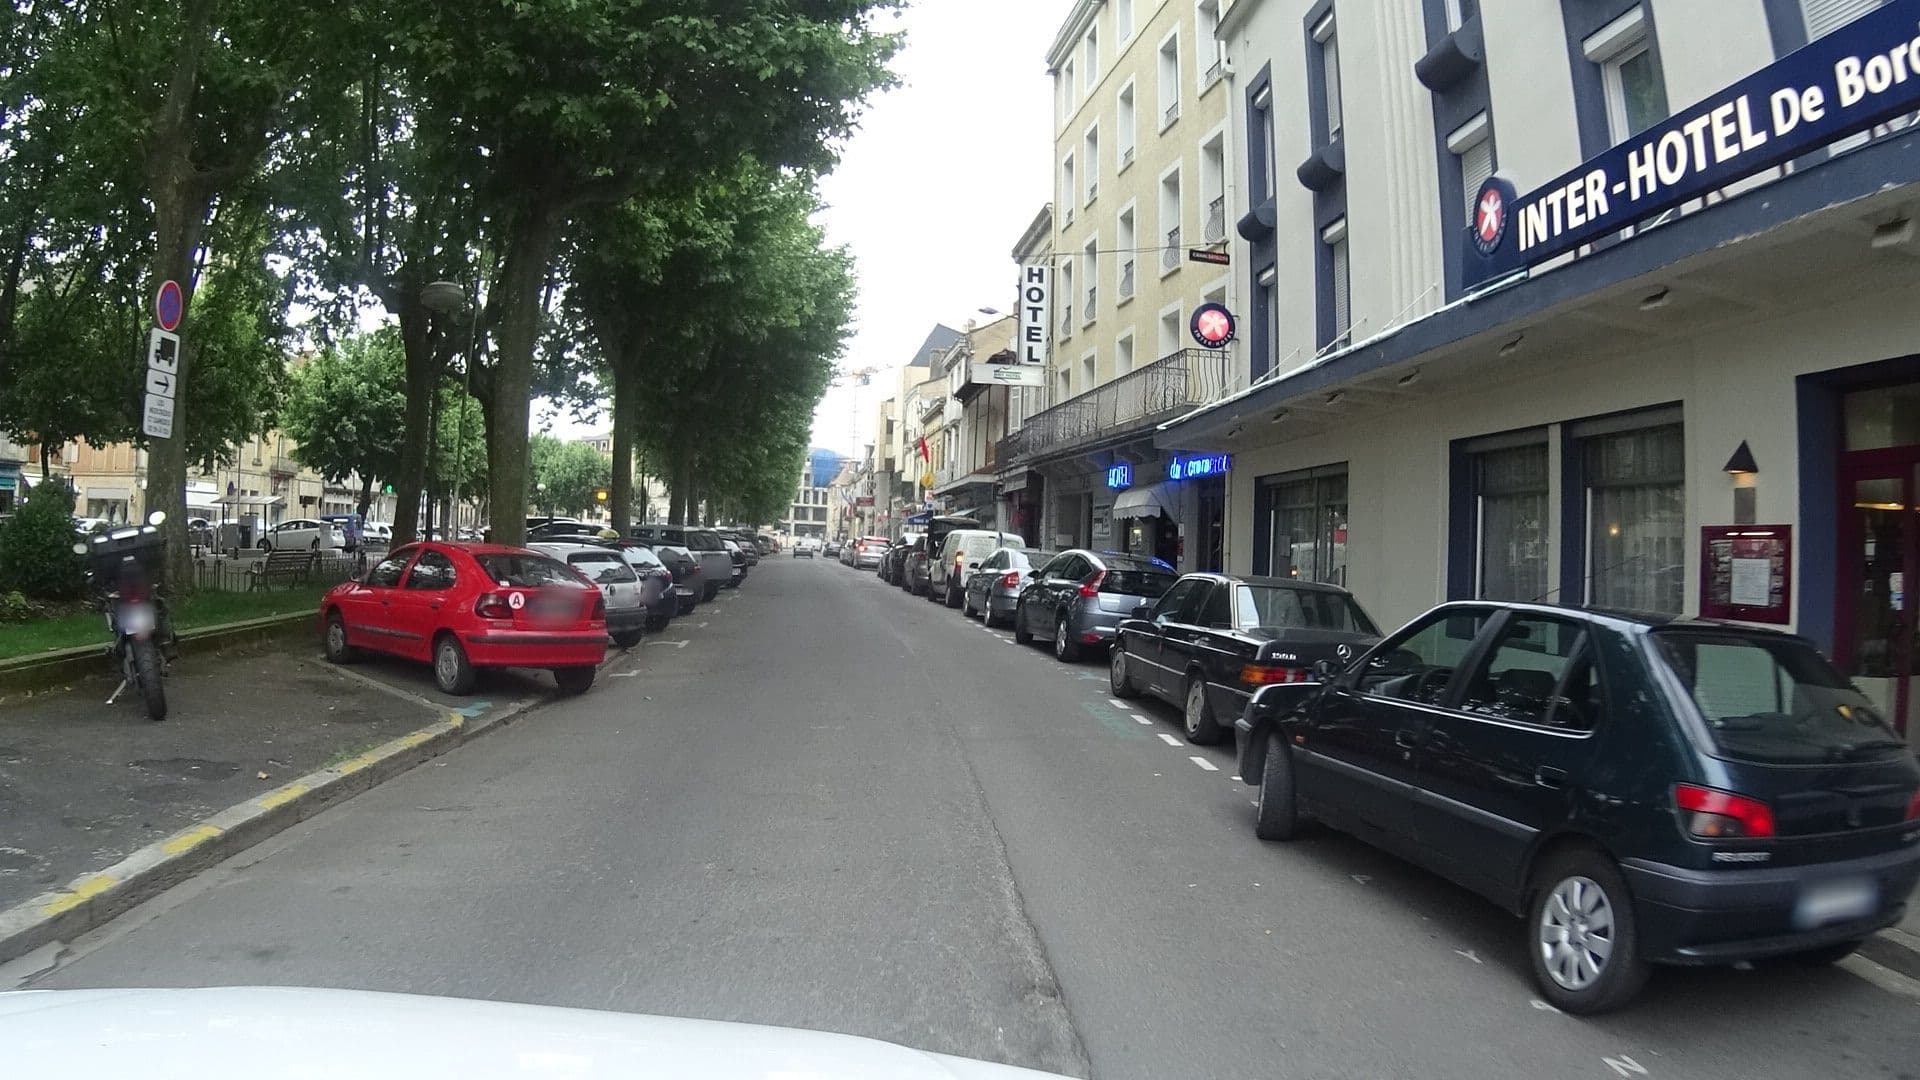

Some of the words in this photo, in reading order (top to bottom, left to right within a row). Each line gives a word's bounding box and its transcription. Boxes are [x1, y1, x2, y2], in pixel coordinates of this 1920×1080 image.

[1771, 87, 1825, 137] De
[1026, 267, 1044, 362] HOTEL
[1108, 466, 1131, 488] HOTEL
[1170, 457, 1181, 479] du
[512, 594, 521, 606] A
